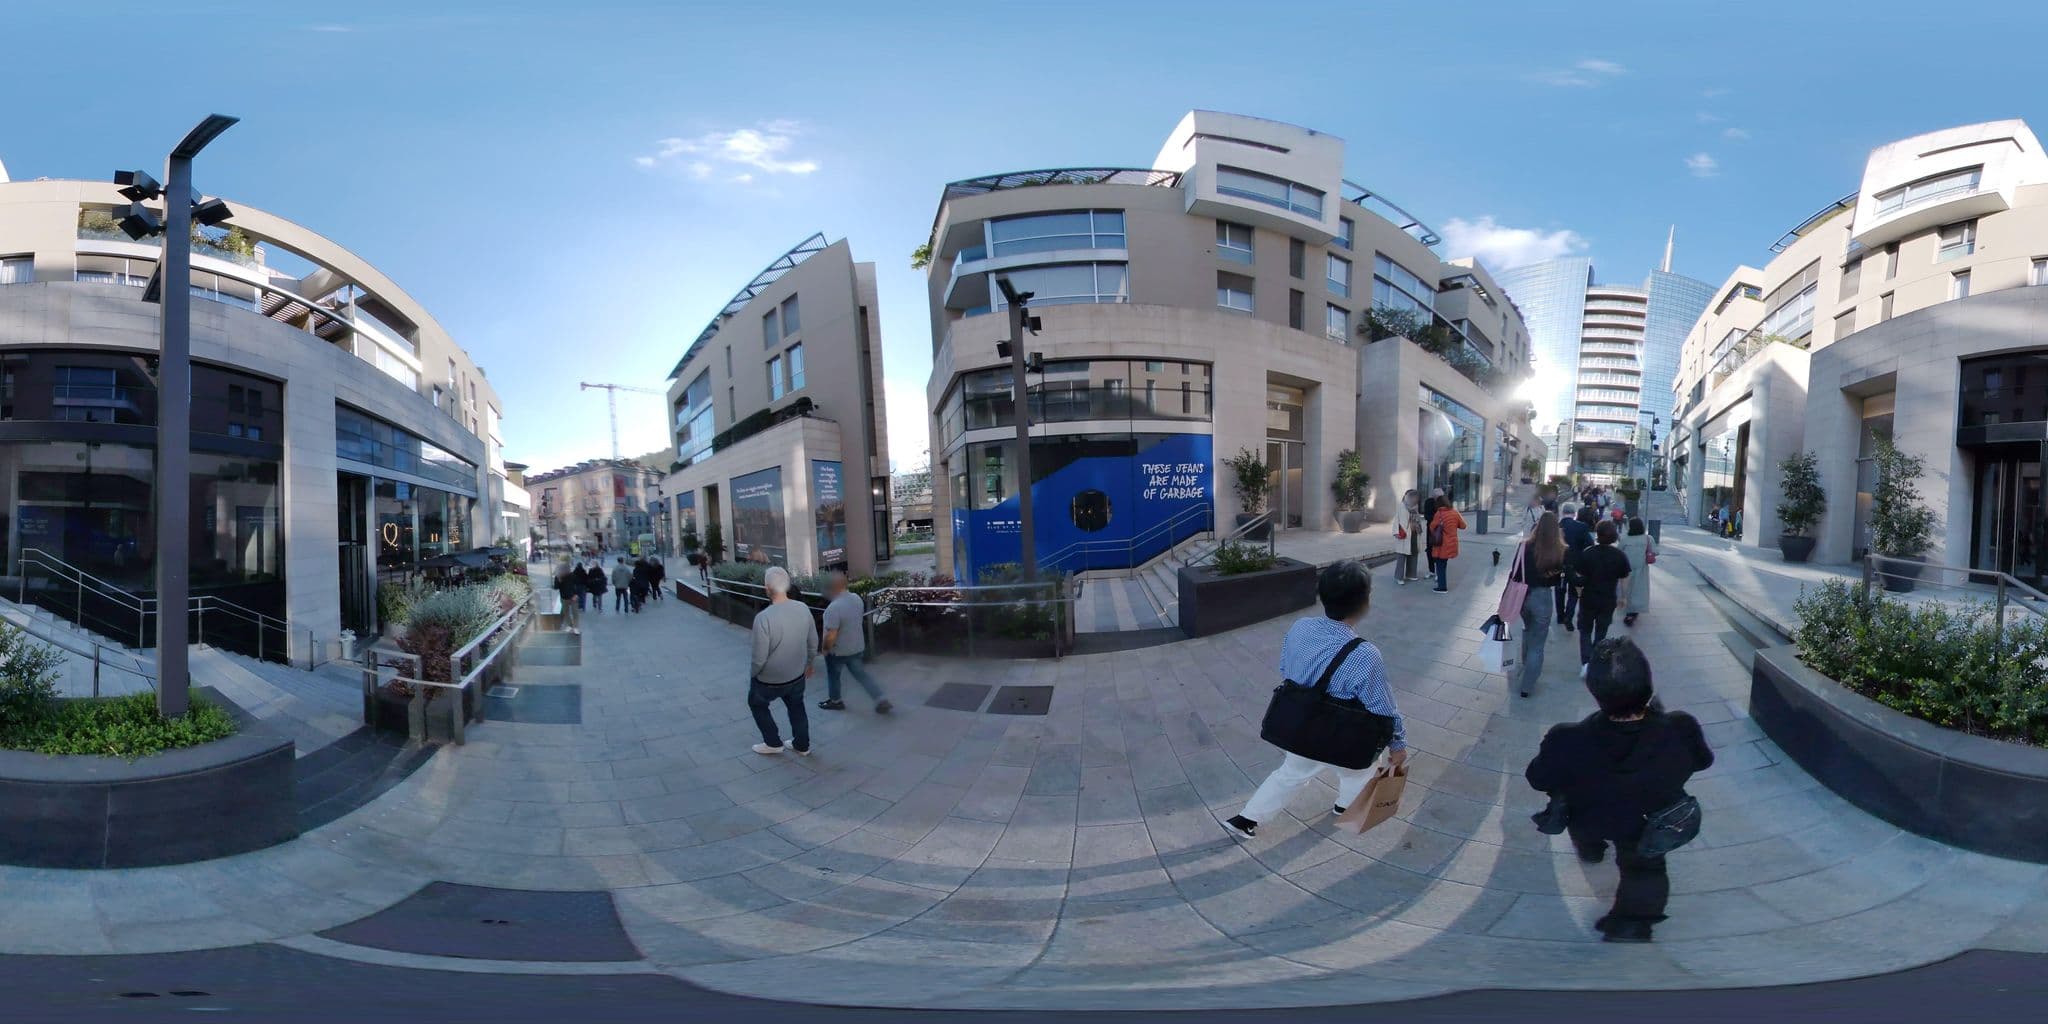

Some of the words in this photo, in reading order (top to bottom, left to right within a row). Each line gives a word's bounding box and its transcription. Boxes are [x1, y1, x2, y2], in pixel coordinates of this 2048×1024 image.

[1142, 463, 1172, 474] THESE
[1175, 463, 1205, 474] JEANS
[1149, 474, 1170, 487] ARE
[1171, 474, 1198, 487] MADE
[1143, 488, 1157, 500] OF
[1160, 487, 1205, 500] GARBAGE
